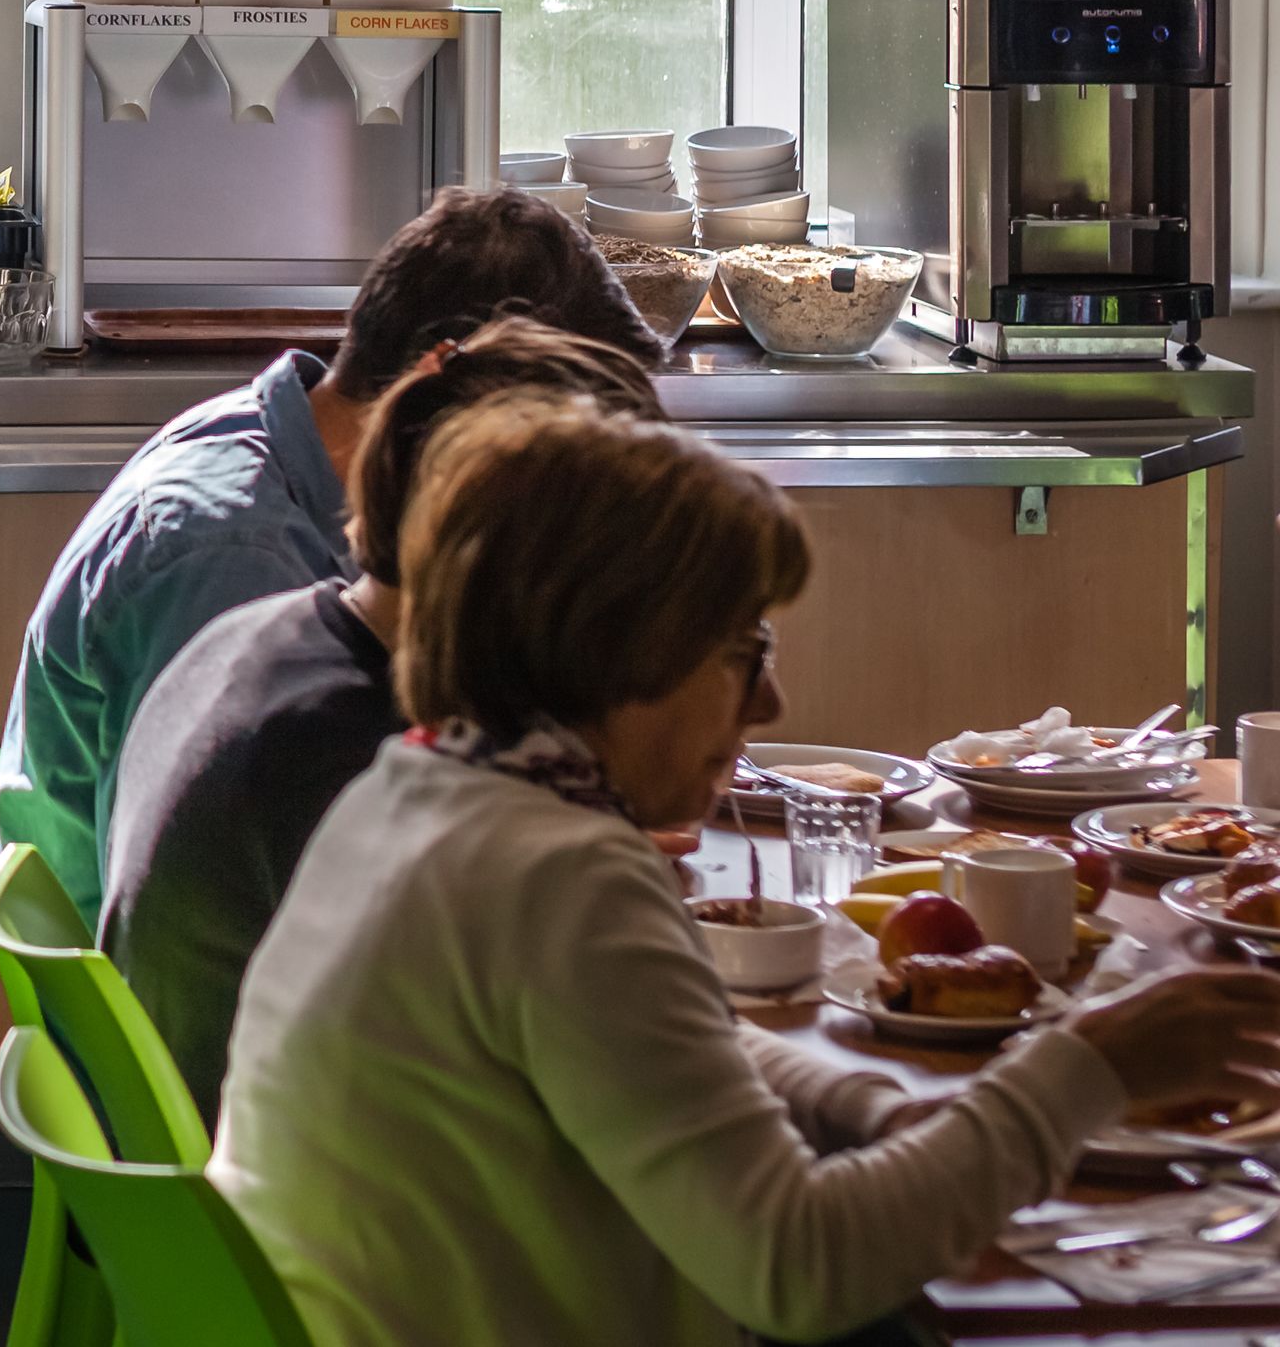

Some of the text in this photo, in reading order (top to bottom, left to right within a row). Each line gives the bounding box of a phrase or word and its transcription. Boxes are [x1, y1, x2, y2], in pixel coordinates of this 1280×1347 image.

[86, 13, 191, 27] CORNFLAKES
[233, 9, 308, 25] FROSTIES
[350, 16, 449, 31] CORN FLAKES
